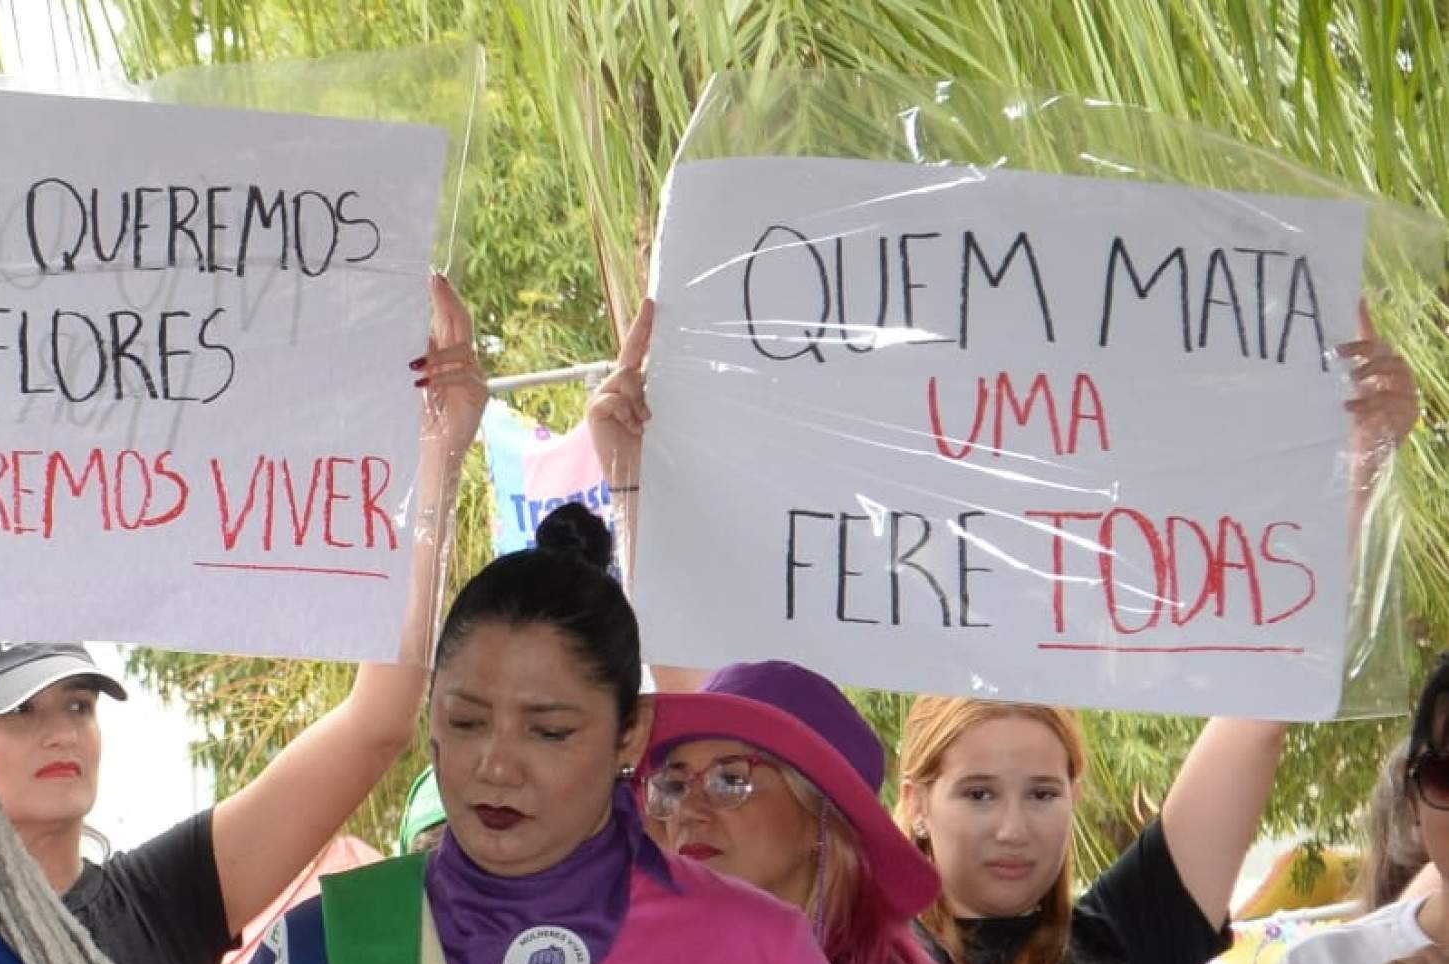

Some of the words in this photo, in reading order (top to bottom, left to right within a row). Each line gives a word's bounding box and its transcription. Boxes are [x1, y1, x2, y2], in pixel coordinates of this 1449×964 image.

[27, 178, 380, 277] QUEREMOS
[744, 225, 1056, 364] QUEM
[1100, 236, 1330, 372] MATA
[928, 372, 1110, 460] UMA
[210, 455, 397, 552] VIVER
[786, 509, 993, 629] FERE
[1025, 508, 1317, 636] TODAS
